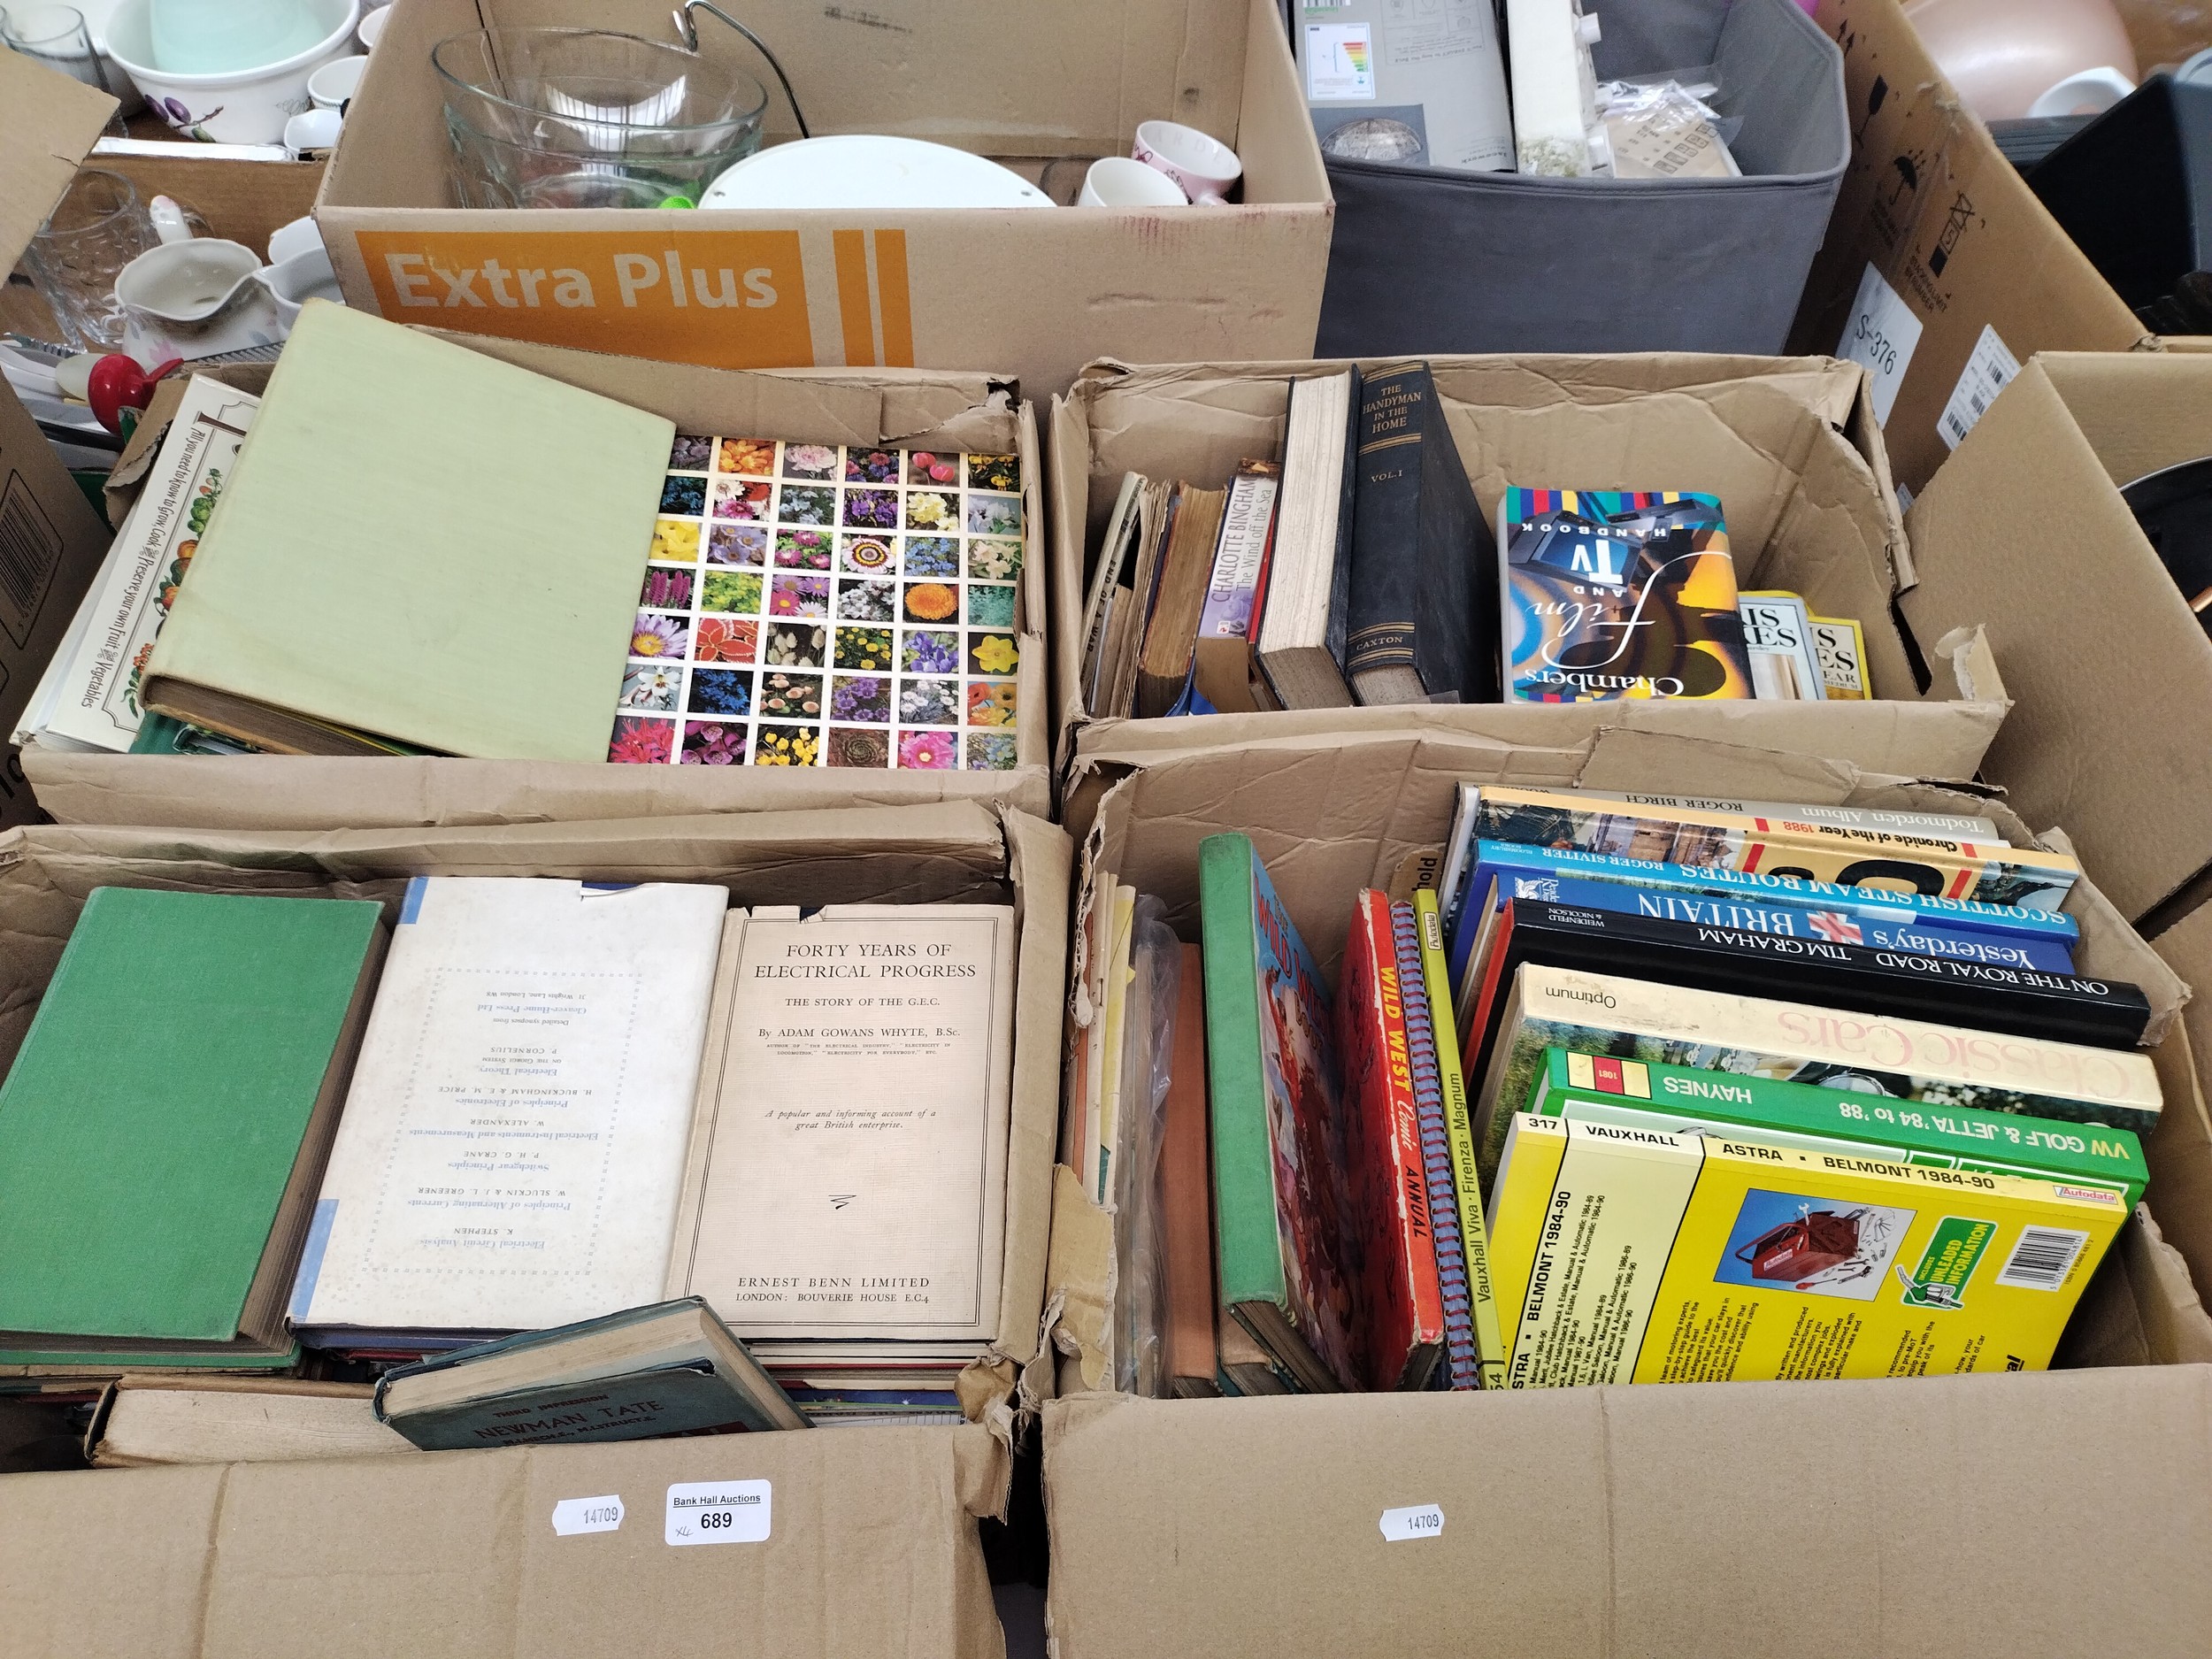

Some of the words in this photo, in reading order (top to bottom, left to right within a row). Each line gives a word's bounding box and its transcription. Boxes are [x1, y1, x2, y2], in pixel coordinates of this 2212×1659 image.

[383, 251, 596, 310] Extra
[611, 250, 780, 310] Plus
[1856, 314, 1897, 375] S-376
[1379, 384, 1402, 396] THE
[1363, 391, 1422, 414] HANDYMAN
[1373, 411, 1386, 421] IN
[1387, 406, 1408, 419] THE
[191, 427, 206, 442] All
[1371, 416, 1408, 434] HOME
[186, 437, 199, 457] you
[178, 452, 193, 473] need
[1256, 489, 1272, 503] Sea
[1252, 507, 1268, 522] the
[147, 526, 166, 548] Cook
[1248, 524, 1264, 538] off
[1522, 522, 1667, 538] HANDBOOK
[1211, 534, 1245, 603] CHARLOTTE
[1228, 478, 1256, 531] BINGHAM
[1241, 541, 1261, 569] Wind
[1571, 538, 1624, 585] TV
[128, 557, 154, 591] Preserve
[1236, 572, 1254, 592] The
[120, 589, 139, 614] your
[1572, 586, 1624, 598] AND
[114, 611, 130, 628] own
[104, 626, 126, 653] Fruit
[1356, 634, 1403, 651] CAXTON
[81, 661, 113, 709] Vegetables
[1525, 668, 1685, 698] Chambers
[1625, 795, 1678, 808] BIRCH
[1685, 799, 1743, 812] ROGER
[1801, 807, 1863, 823] Album
[1872, 812, 1985, 833] Todmorden
[1783, 821, 1815, 833] 1988
[1818, 826, 1851, 839] Year
[1852, 829, 1875, 841] the
[1878, 833, 1892, 843] of
[1893, 834, 1958, 852] Chronicle
[1542, 848, 1607, 864] SIVITER
[1610, 855, 1665, 872] ROGER
[1680, 864, 1801, 892] ROUTES
[1809, 879, 1913, 906] STEAM
[1548, 908, 1594, 919] NICOLSON
[1639, 893, 1793, 936] BRITAIN
[1919, 894, 2067, 925] SCOTTISH
[1548, 914, 1605, 928] WEIDENFELD
[786, 943, 850, 958] FORTY
[858, 943, 917, 958] YEARS
[926, 943, 952, 958] OF
[1699, 928, 1804, 956] GRAHAM
[1873, 928, 2037, 971] Yesterday's
[1808, 942, 1853, 963] TIM
[754, 964, 871, 979] ELECTRICAL
[879, 964, 977, 979] PROGRESS
[1876, 952, 1943, 974] ROAD
[1946, 960, 2024, 986] ROYAL
[2024, 972, 2070, 992] THE
[1379, 966, 1400, 1019] WILD
[2070, 978, 2109, 996] ON
[785, 998, 810, 1007] THE
[814, 998, 854, 1007] STORY
[858, 998, 875, 1007] OF
[879, 998, 903, 1007] THE
[908, 998, 941, 1007] G.E.C.
[1546, 986, 1617, 1010] Optimum
[758, 1028, 772, 1040] By
[778, 1028, 815, 1037] ADAM
[821, 1028, 874, 1037] GOWANS
[880, 1028, 928, 1039] WHYTE,
[1777, 1010, 1914, 1068] Cars
[1388, 1032, 1410, 1092] WEST
[1921, 1033, 2131, 1100] Classic
[1598, 1069, 1618, 1080] 1081
[1663, 1076, 1753, 1105] HAYNES
[456, 1097, 506, 1107] Electronics
[522, 1098, 568, 1108] Principles
[1449, 1072, 1467, 1130] Magnum
[778, 1109, 810, 1119] popular
[815, 1109, 833, 1118] and
[835, 1109, 877, 1119] informing
[918, 1109, 928, 1119] of
[1875, 1109, 1895, 1124] to
[409, 1129, 474, 1139] Measurements
[795, 1122, 820, 1131] great
[824, 1120, 854, 1129] British
[858, 1121, 903, 1131] enterprise.
[1395, 1100, 1416, 1150] Comic
[1932, 1115, 2000, 1141] JETTA
[2004, 1125, 2020, 1141] &
[478, 1131, 495, 1140] and
[497, 1131, 553, 1141] Instruments
[555, 1132, 598, 1141] Electrical
[2026, 1130, 2085, 1153] GOLF
[1528, 1118, 1557, 1131] 317
[1586, 1125, 1679, 1148] VAUXHALL
[1722, 1143, 1785, 1162] ASTRA
[1824, 1156, 1913, 1179] BELMONT
[1916, 1169, 1995, 1190] 1984-90
[2091, 1140, 2131, 1161] VW
[448, 1160, 495, 1171] Principles
[498, 1162, 549, 1171] Switchgear
[1459, 1140, 1475, 1193] Firenza
[1404, 1165, 1428, 1238] ANNUAL
[2057, 1187, 2116, 1203] Autodata
[1467, 1204, 1482, 1235] Viva
[1930, 1240, 1962, 1283] UNLEADED
[1944, 1223, 1988, 1286] INFORMATION
[1470, 1240, 1491, 1303] Vauxhall
[738, 1277, 800, 1288] ERNEST
[809, 1277, 852, 1288] BENN
[861, 1277, 930, 1288] LIMITED
[1512, 1353, 1532, 1390] STRA
[1526, 1252, 1554, 1321] BELMONT
[1544, 1191, 1571, 1248] 1984-90
[735, 1293, 788, 1302] LONDON:
[796, 1293, 854, 1302] BOUVERIE
[860, 1293, 897, 1302] HOUSE
[472, 1413, 588, 1439] NEWMAN
[597, 1401, 664, 1417] TATE
[673, 1496, 697, 1507] Bank
[699, 1495, 718, 1506] Hall
[719, 1494, 761, 1505] Auctions
[582, 1506, 618, 1525] 14709
[700, 1511, 733, 1530] 689
[1408, 1513, 1440, 1530] 14709
